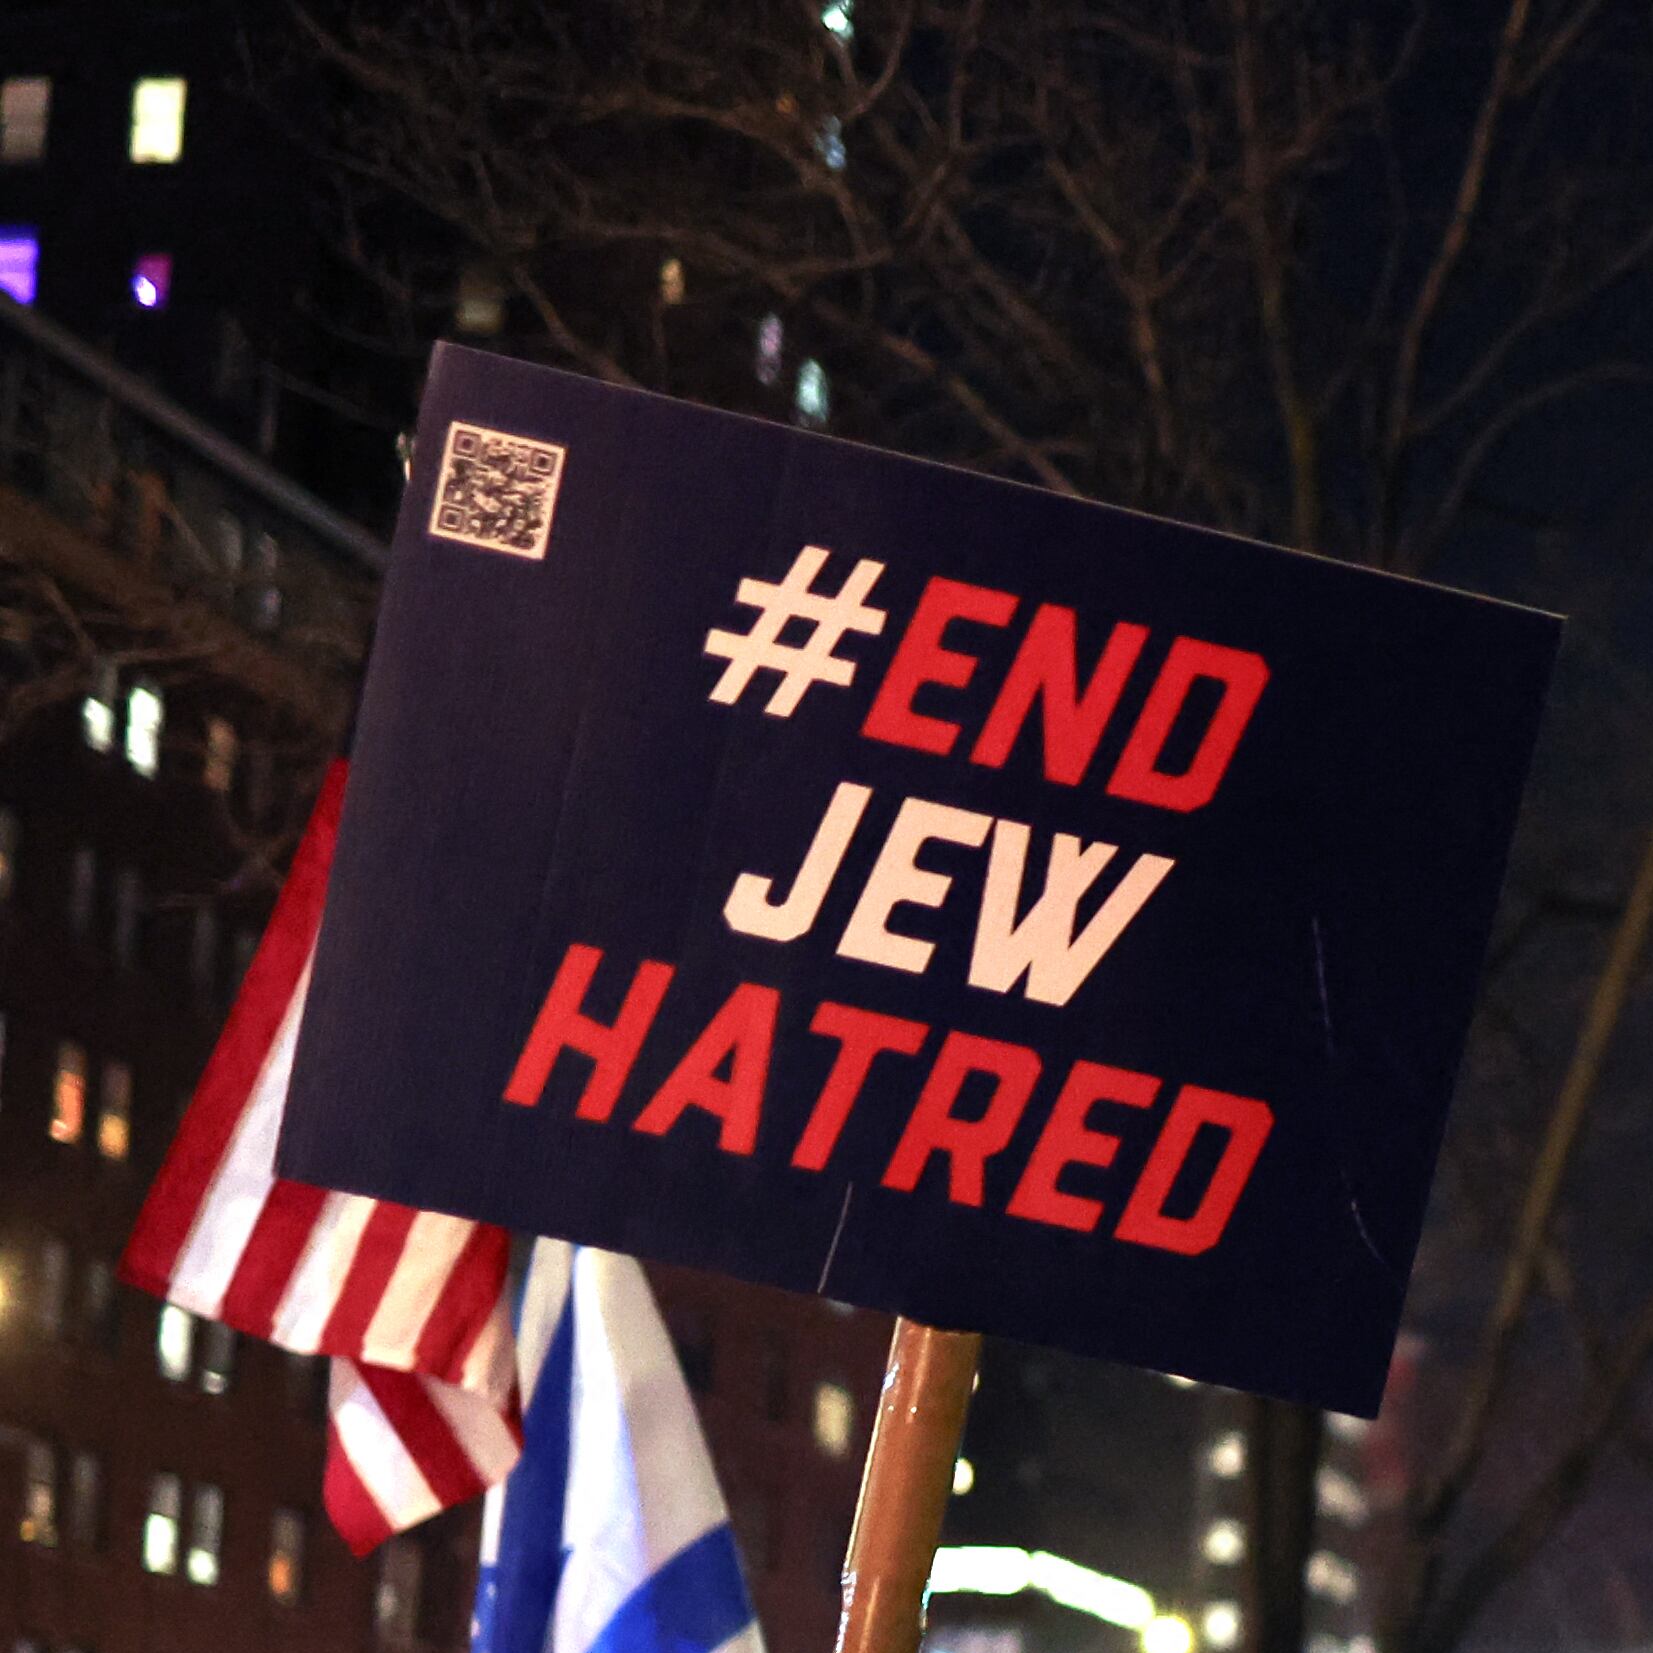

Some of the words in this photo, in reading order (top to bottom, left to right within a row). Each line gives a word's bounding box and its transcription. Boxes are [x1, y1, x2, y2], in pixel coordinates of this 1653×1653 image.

[704, 544, 1269, 813] #END
[723, 782, 1175, 1008] JEW
[501, 943, 1274, 1257] HATRED
